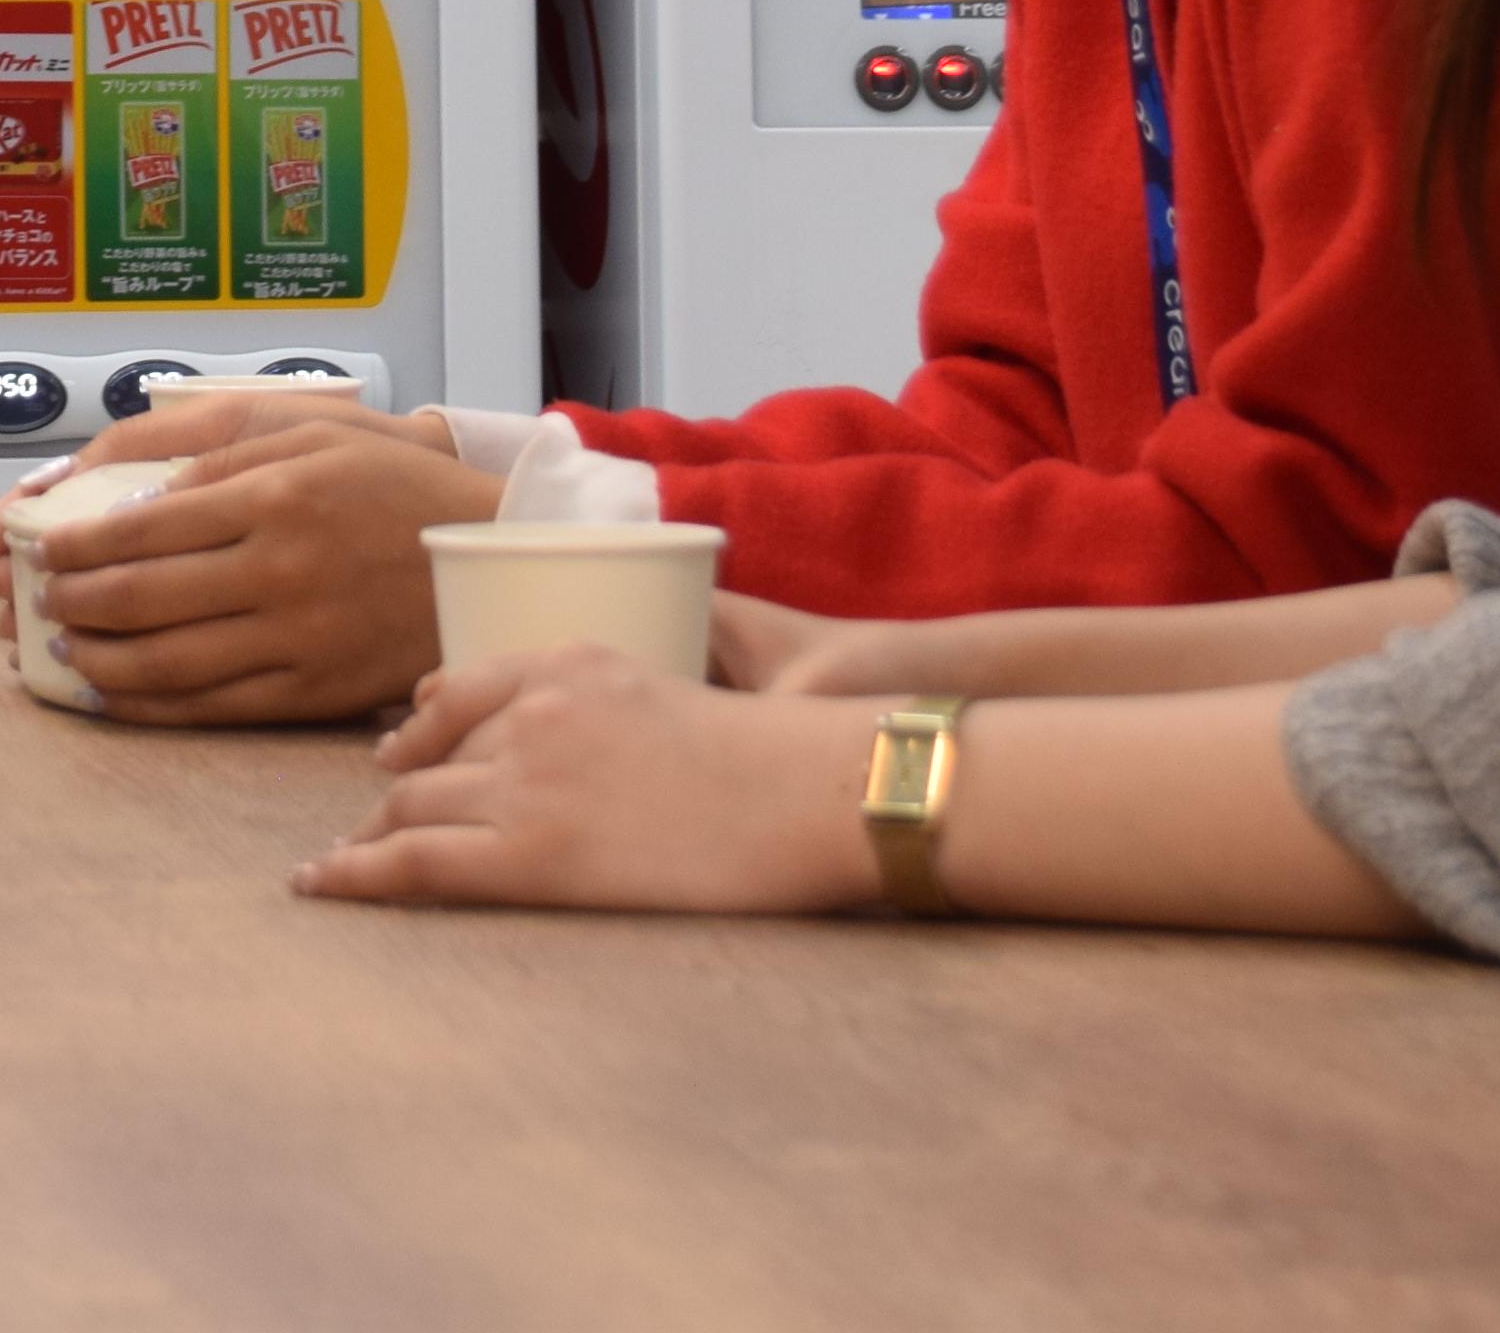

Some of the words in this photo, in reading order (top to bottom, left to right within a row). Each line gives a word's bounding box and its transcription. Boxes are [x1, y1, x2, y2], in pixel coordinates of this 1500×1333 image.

[101, 0, 203, 55] PRETZ
[243, 3, 345, 61] PRETZ
[45, 59, 71, 71] ミニ
